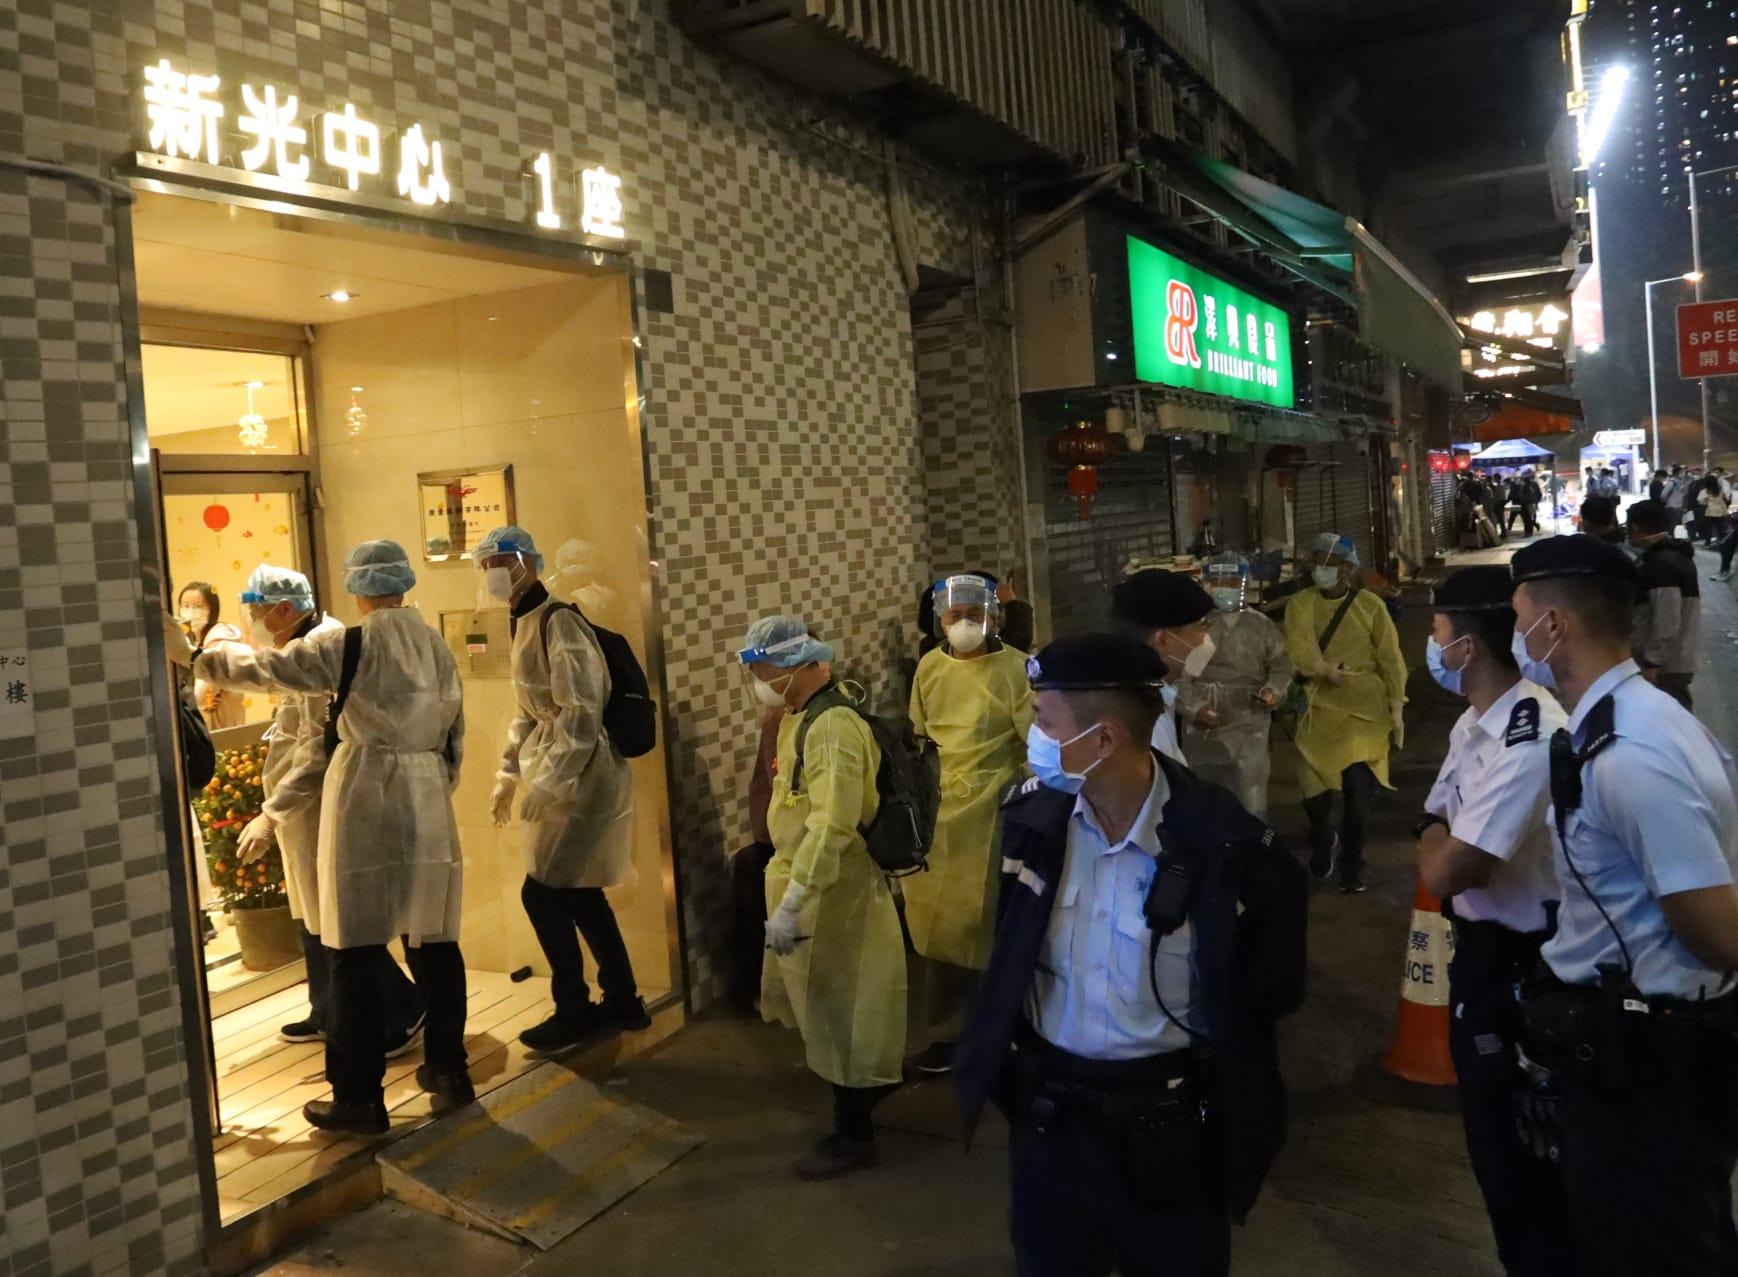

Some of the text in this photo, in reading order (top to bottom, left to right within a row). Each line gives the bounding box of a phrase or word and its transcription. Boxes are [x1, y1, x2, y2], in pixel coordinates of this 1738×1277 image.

[143, 58, 449, 205] 新光中心
[1689, 329, 1738, 346] SPEE
[1207, 349, 1278, 388] BRILLIANT FOOD
